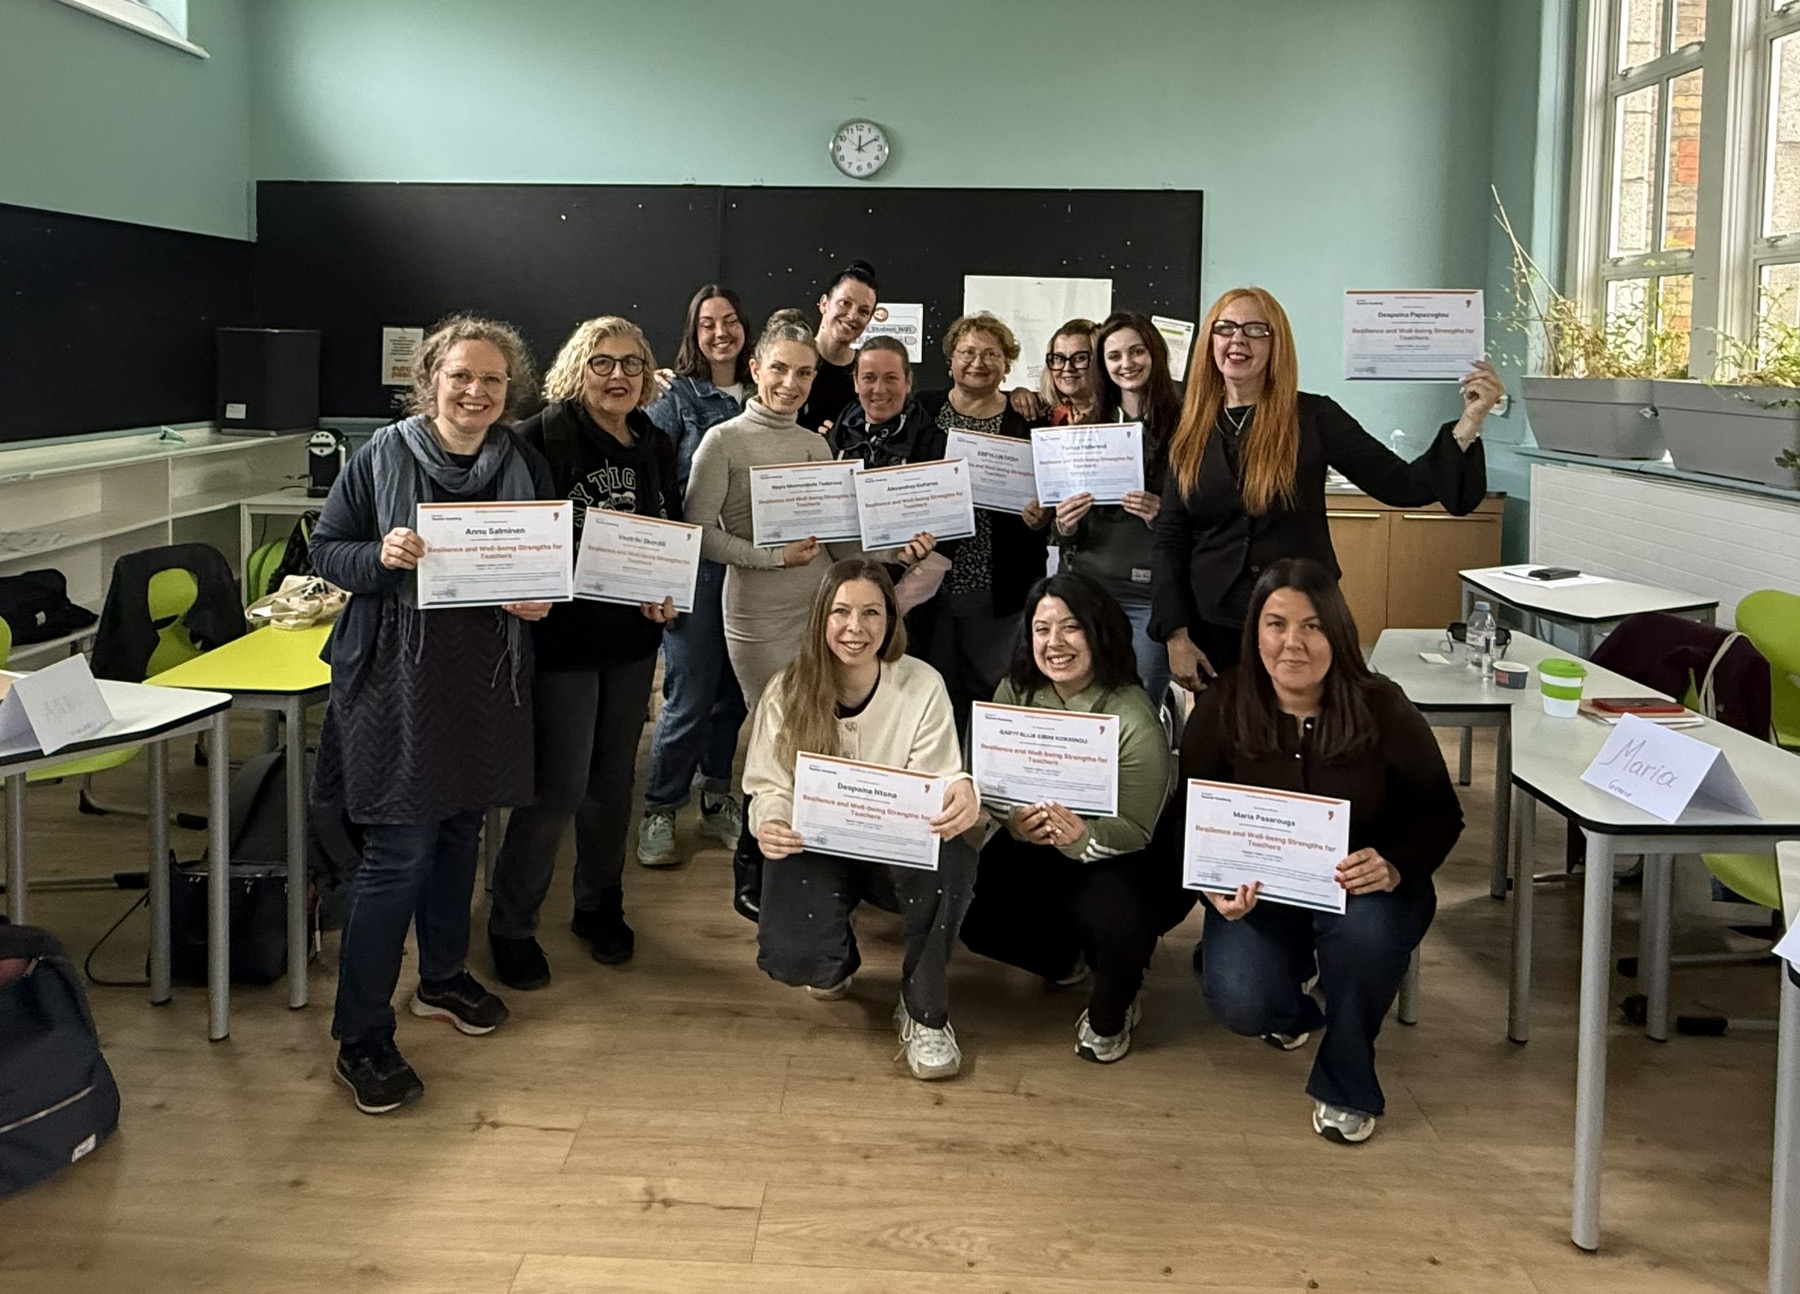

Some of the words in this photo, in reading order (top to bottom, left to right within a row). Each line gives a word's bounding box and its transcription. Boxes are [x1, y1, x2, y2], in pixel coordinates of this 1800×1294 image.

[877, 144, 882, 152] 3
[489, 527, 525, 535] Salminen
[479, 545, 517, 553] Well-being
[518, 544, 551, 552] Strengths
[981, 743, 1013, 753] Resilience
[1028, 749, 1063, 760] Well-being
[1064, 753, 1097, 763] Strengths
[1028, 757, 1059, 766] Teachers
[1599, 738, 1678, 788] Maria
[837, 782, 873, 795] Despoina
[803, 794, 836, 805] Resilience
[850, 802, 886, 815] Well-being
[887, 808, 919, 819] Strengths
[850, 810, 881, 820] Teachers
[1233, 811, 1255, 820] Maria
[1195, 825, 1231, 836] Resilience
[1232, 829, 1246, 837] and
[1247, 832, 1286, 845] Well-being
[1288, 838, 1323, 851] Strengths
[1325, 844, 1336, 852] for
[1248, 839, 1281, 851] Teachers
